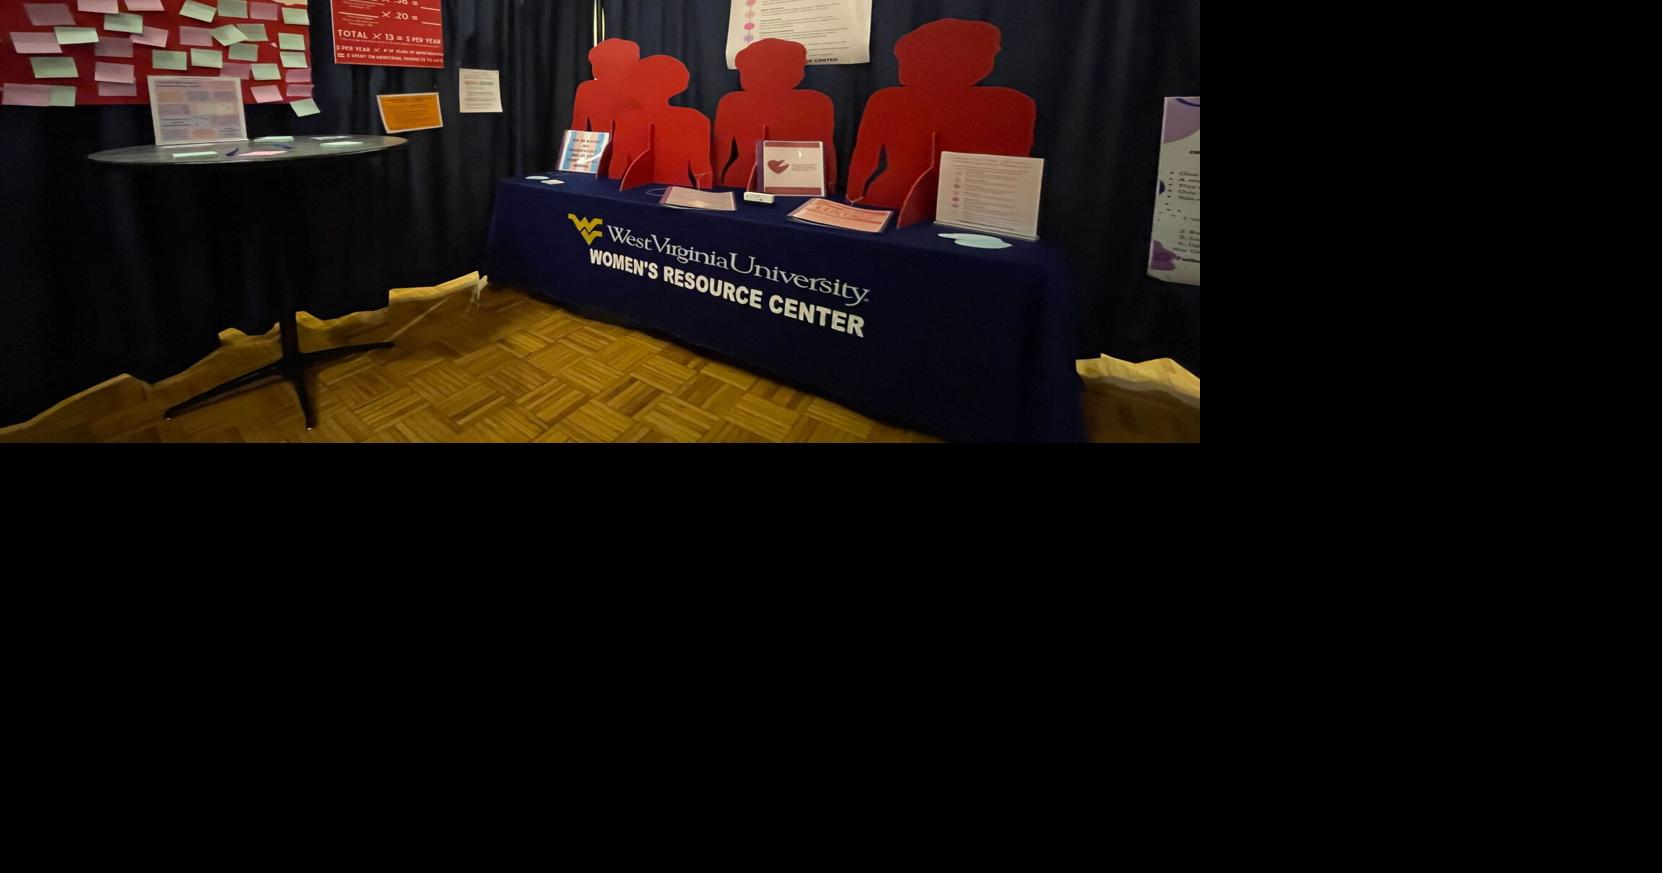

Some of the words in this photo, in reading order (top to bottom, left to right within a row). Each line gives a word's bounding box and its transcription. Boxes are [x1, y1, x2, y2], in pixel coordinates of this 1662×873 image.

[337, 29, 368, 39] TOTAL
[607, 225, 652, 250] West
[650, 234, 728, 270] Virginia
[589, 248, 658, 280] WOMEN'S
[663, 266, 762, 309] RESOURCE
[768, 294, 865, 338] CENTER
